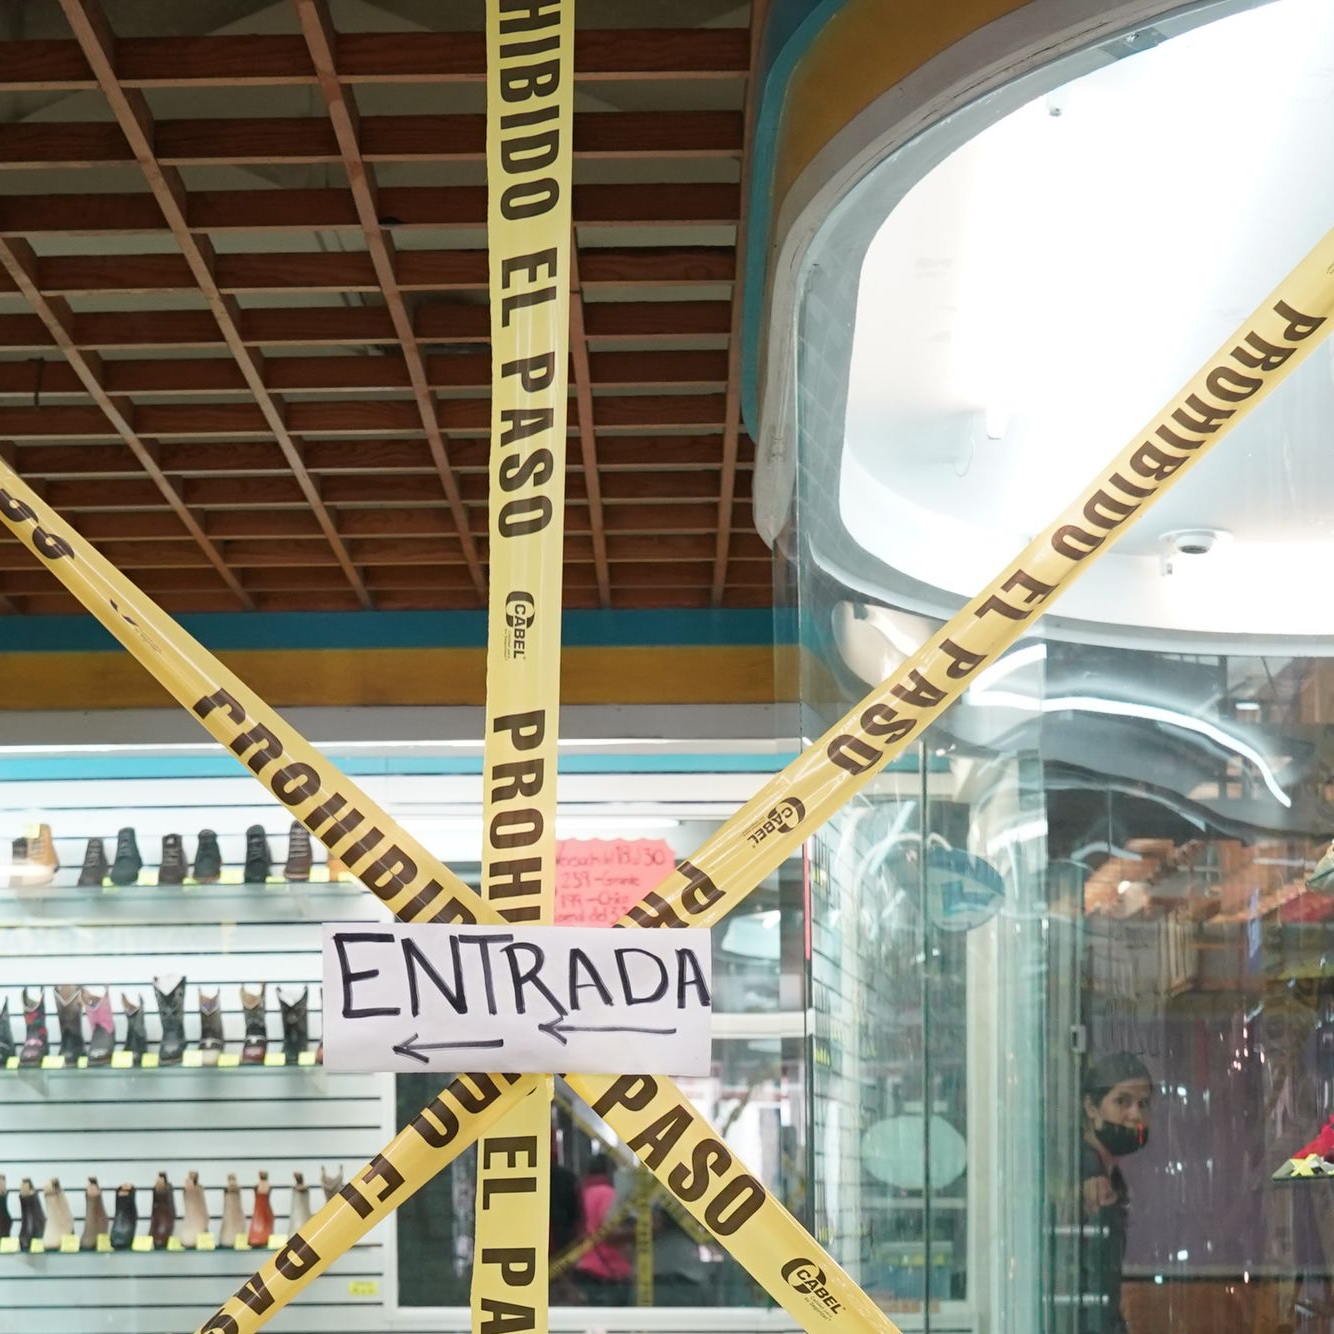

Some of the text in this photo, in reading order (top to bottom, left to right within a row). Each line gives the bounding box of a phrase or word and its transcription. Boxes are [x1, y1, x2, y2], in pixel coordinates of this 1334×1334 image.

[500, 246, 558, 328] EL
[498, 351, 555, 538] PASO
[827, 300, 1327, 777] PROHIBIDO EL PASO
[333, 932, 712, 1019] ENTRADA
[481, 1135, 538, 1211] EL
[591, 1074, 767, 1237] PASO
